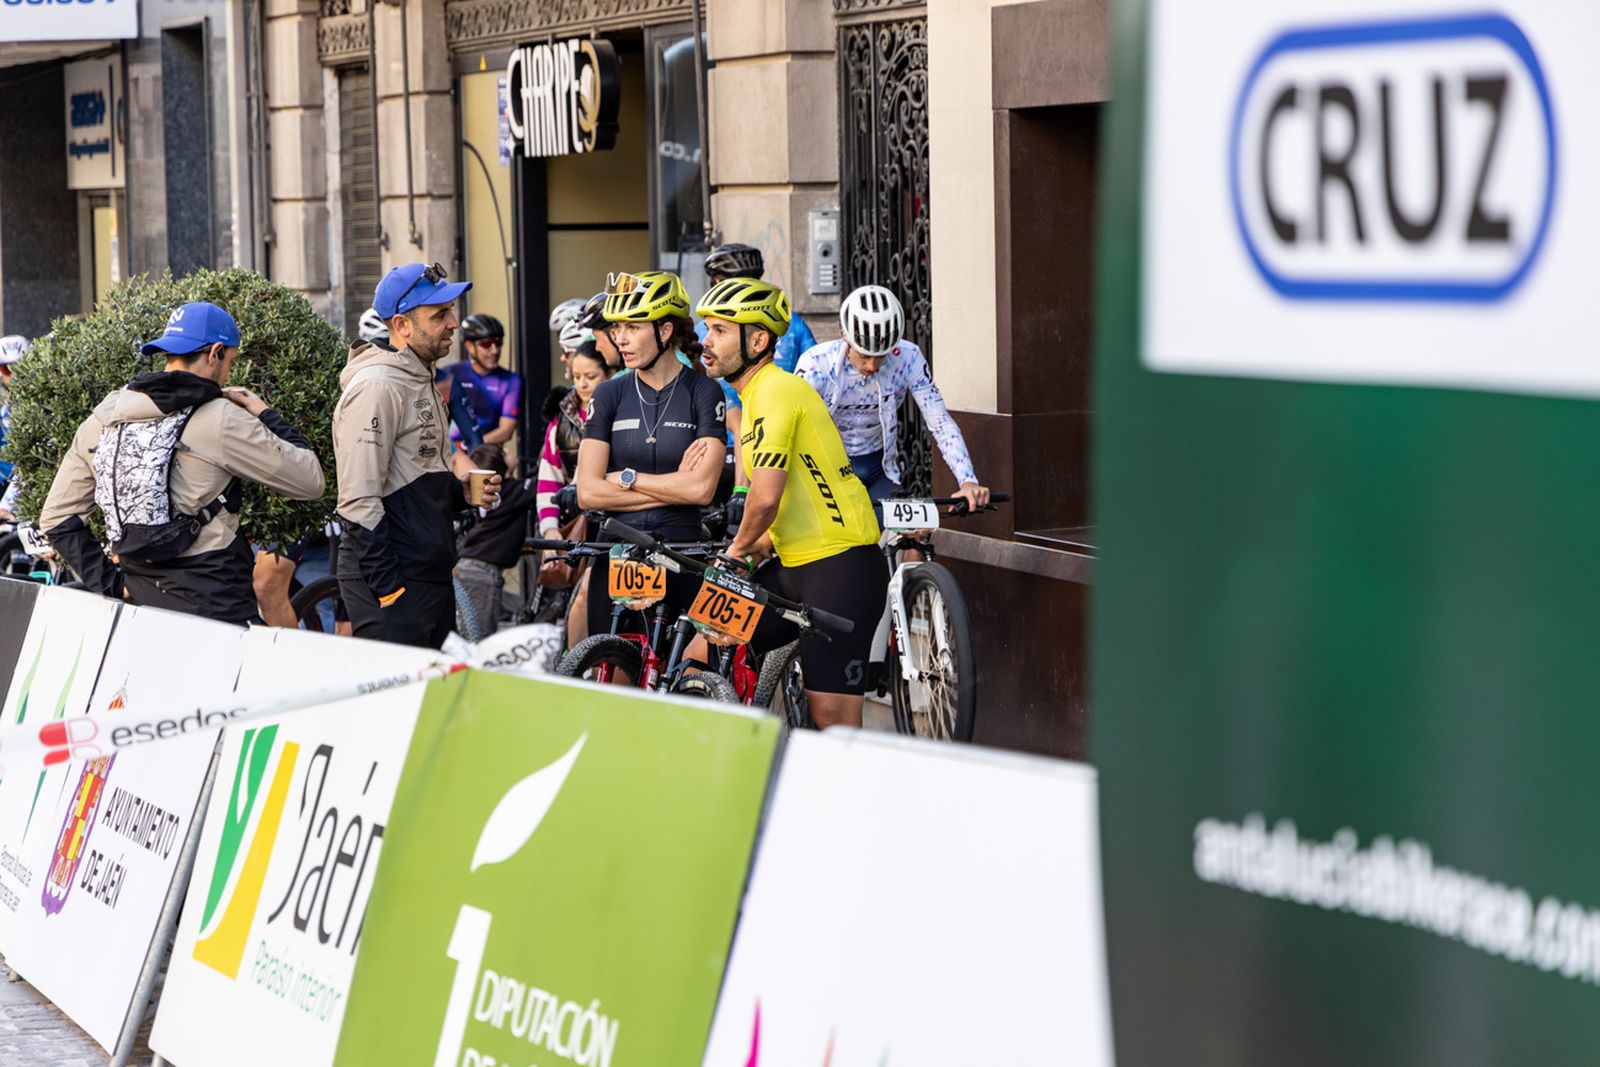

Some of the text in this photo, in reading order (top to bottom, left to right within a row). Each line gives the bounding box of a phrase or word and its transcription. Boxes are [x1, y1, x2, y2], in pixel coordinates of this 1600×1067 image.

[1259, 71, 1510, 247] CRUZ
[651, 296, 677, 311] SCOTT
[740, 304, 771, 312] SCOTT
[662, 421, 697, 430] SCOTT
[799, 452, 845, 528] SCOTT
[893, 503, 928, 523] 49-1
[613, 563, 662, 590] 705-2
[698, 586, 756, 632] 705-1
[102, 786, 180, 860] AYUNTAMIENTO
[267, 744, 386, 957] Jaén
[81, 849, 104, 893] DE
[95, 853, 128, 909] JAÉN
[474, 968, 620, 1067] DIPUTACIÓN
